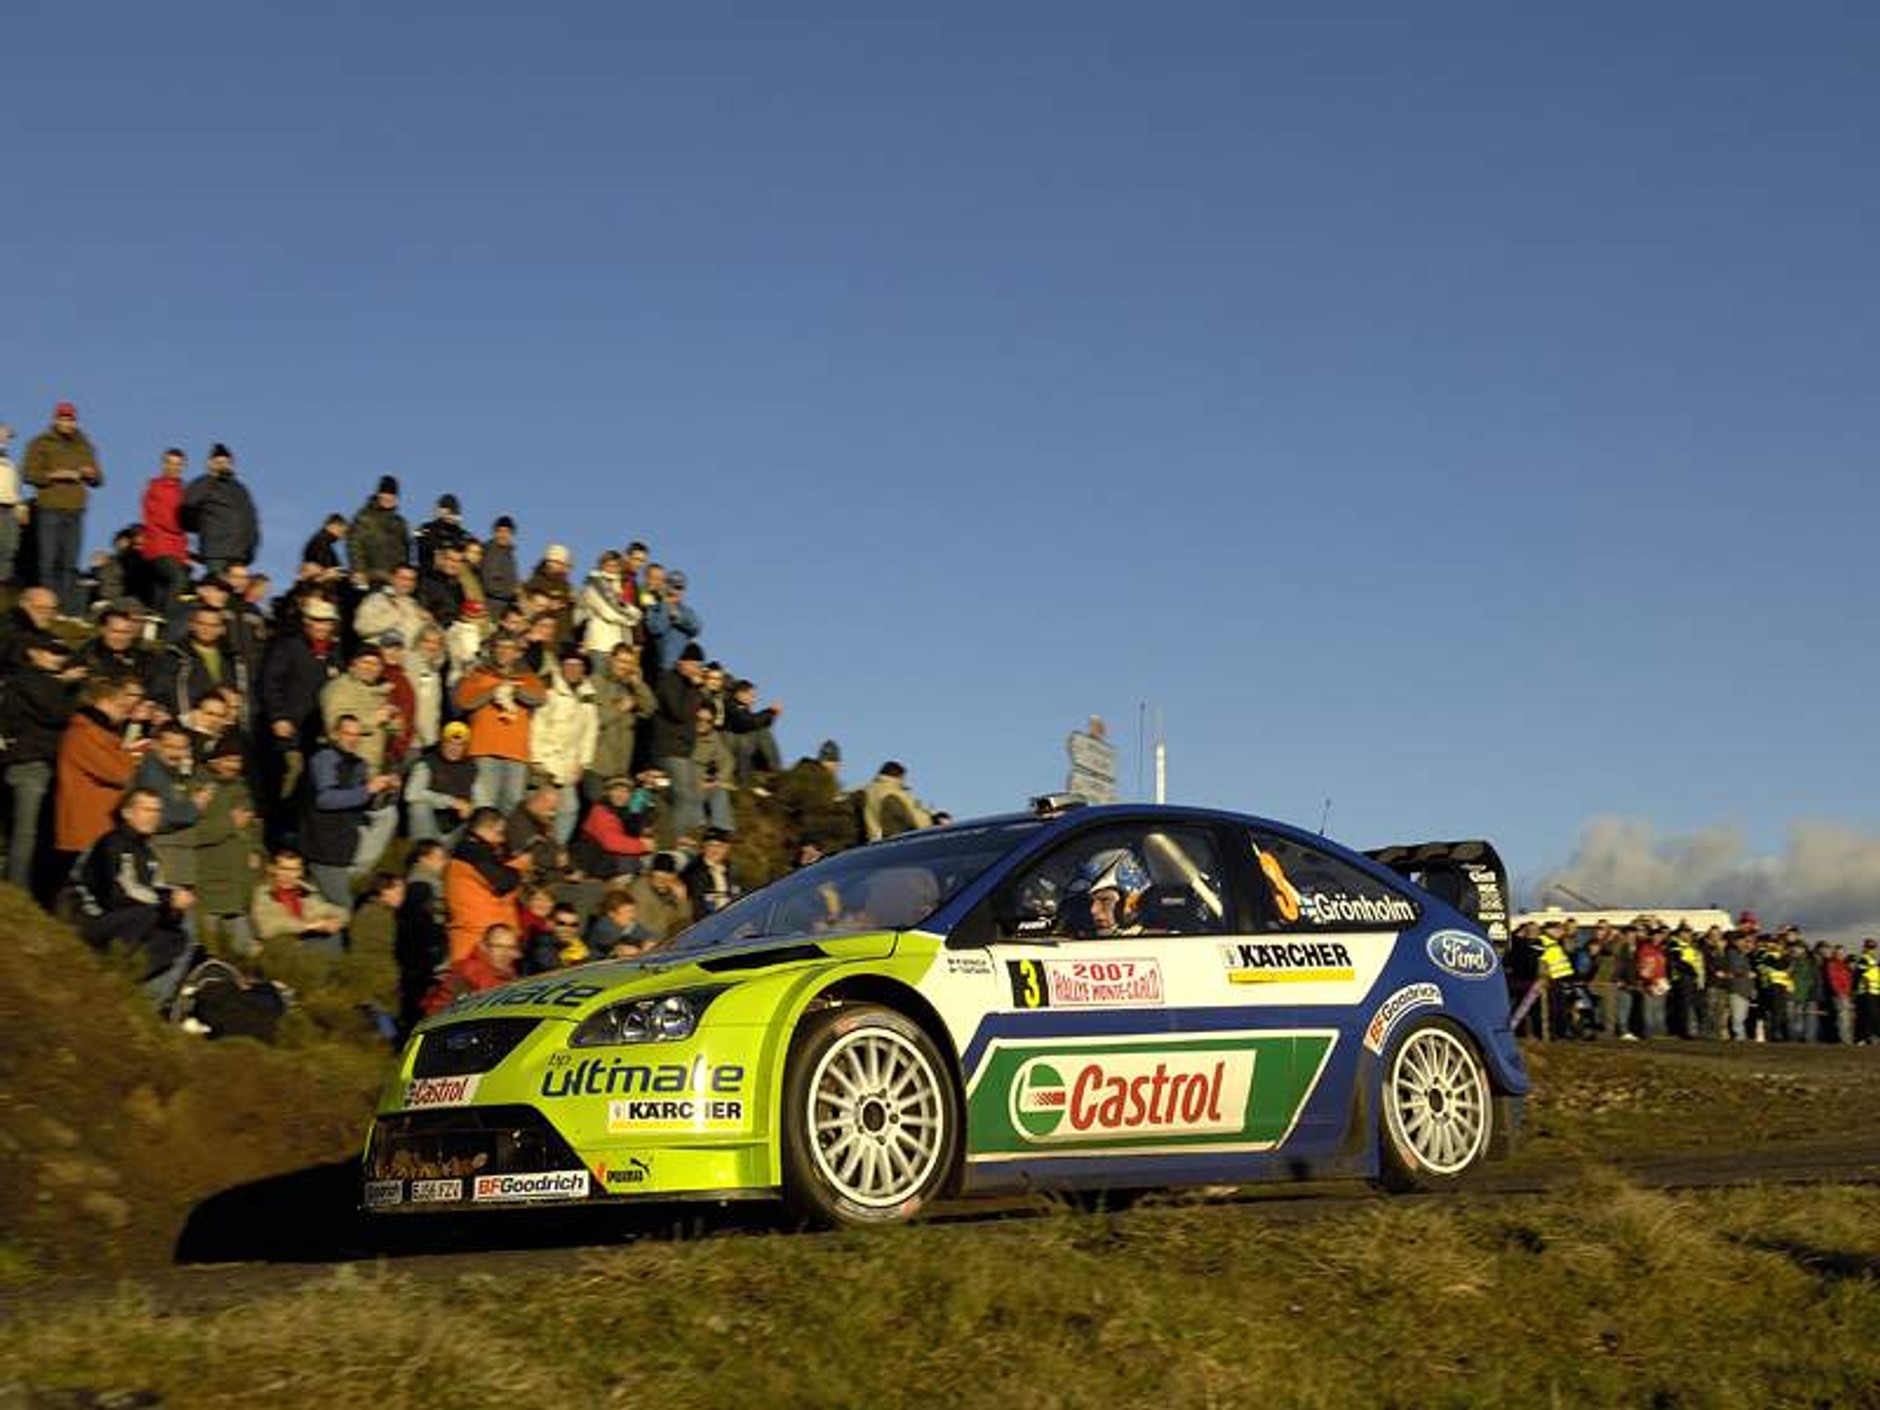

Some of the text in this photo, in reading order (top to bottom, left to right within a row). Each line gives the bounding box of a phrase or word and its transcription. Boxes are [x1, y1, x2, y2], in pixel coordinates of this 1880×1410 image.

[1314, 893, 1415, 922] Grönholm
[1237, 943, 1352, 968] KÄRCHER
[1443, 937, 1488, 969] Ford
[1020, 959, 1041, 1008] 3
[1072, 963, 1136, 982] 2007
[415, 1078, 469, 1105] Castrol
[1069, 1059, 1225, 1131] Castrol
[478, 1175, 584, 1195] BFGoodrich
